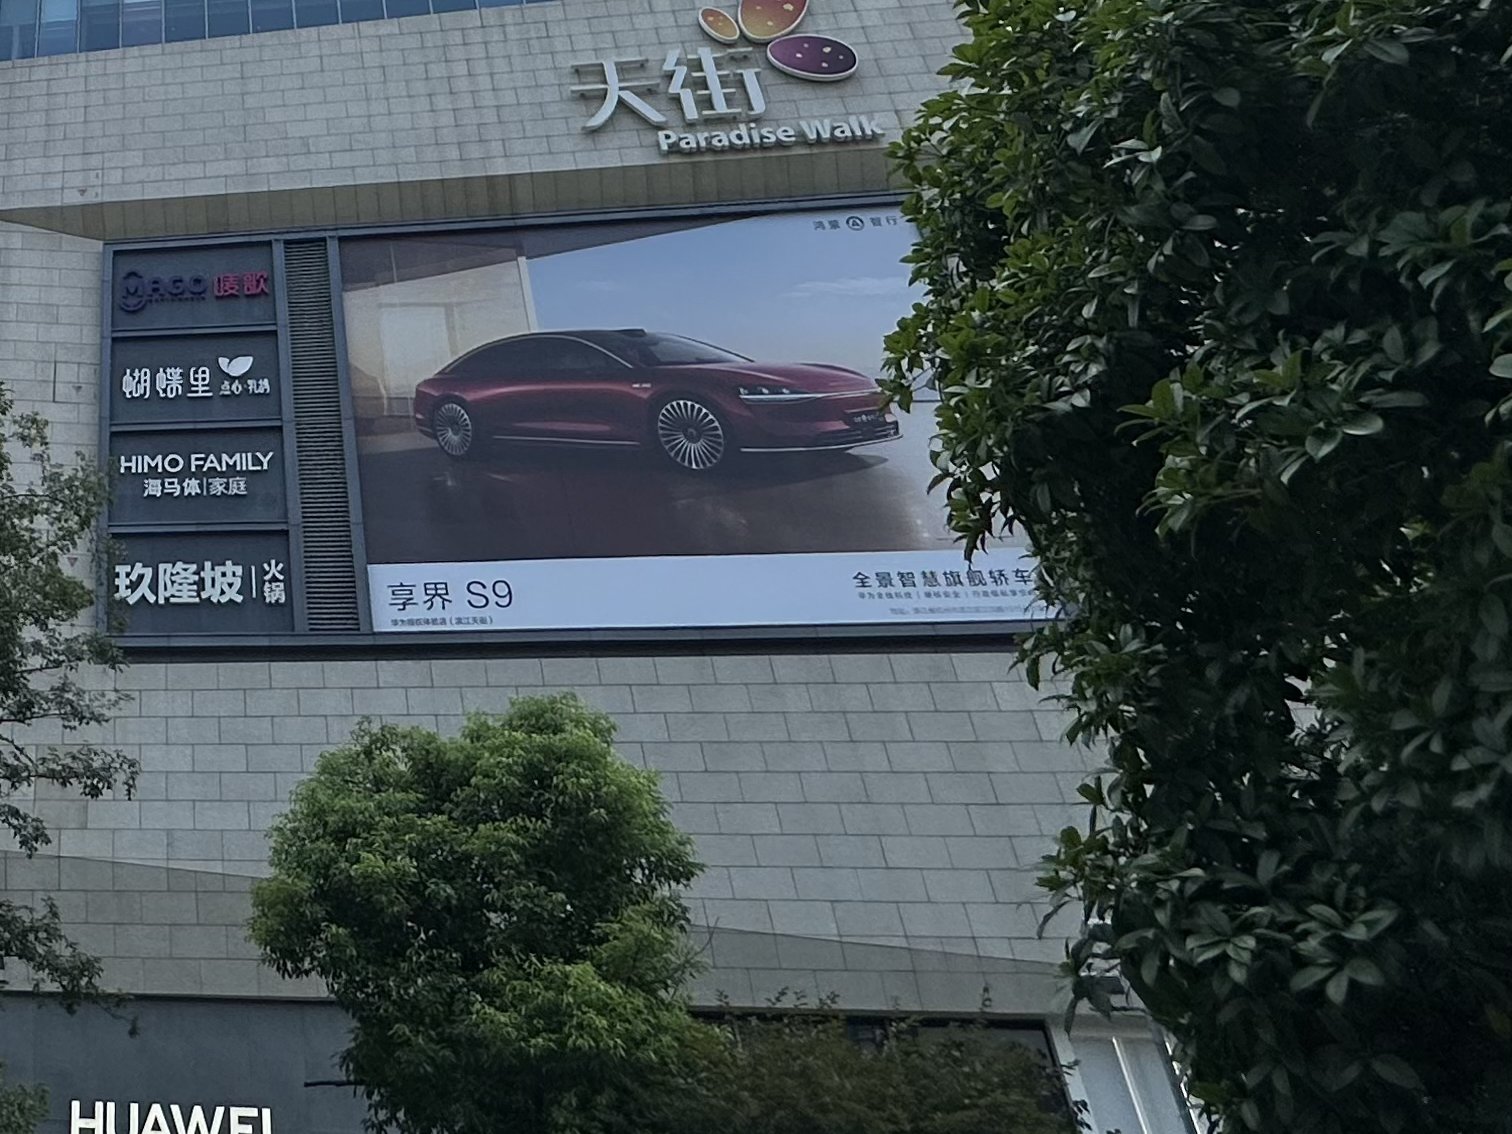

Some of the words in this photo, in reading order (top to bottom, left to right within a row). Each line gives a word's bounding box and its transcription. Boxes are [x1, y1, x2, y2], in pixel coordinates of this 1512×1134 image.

[570, 47, 766, 131] 天街
[657, 121, 796, 154] Paradise
[798, 115, 886, 145] Walk
[122, 366, 213, 399] 蝴蝶里
[120, 453, 184, 473] HIMO
[190, 451, 274, 472] FAMILY
[114, 560, 244, 605] 玖隆坡
[262, 559, 286, 604] 火锅
[387, 582, 452, 611] 享界
[466, 580, 513, 609] S9
[70, 1100, 272, 1134] HUAWEI
